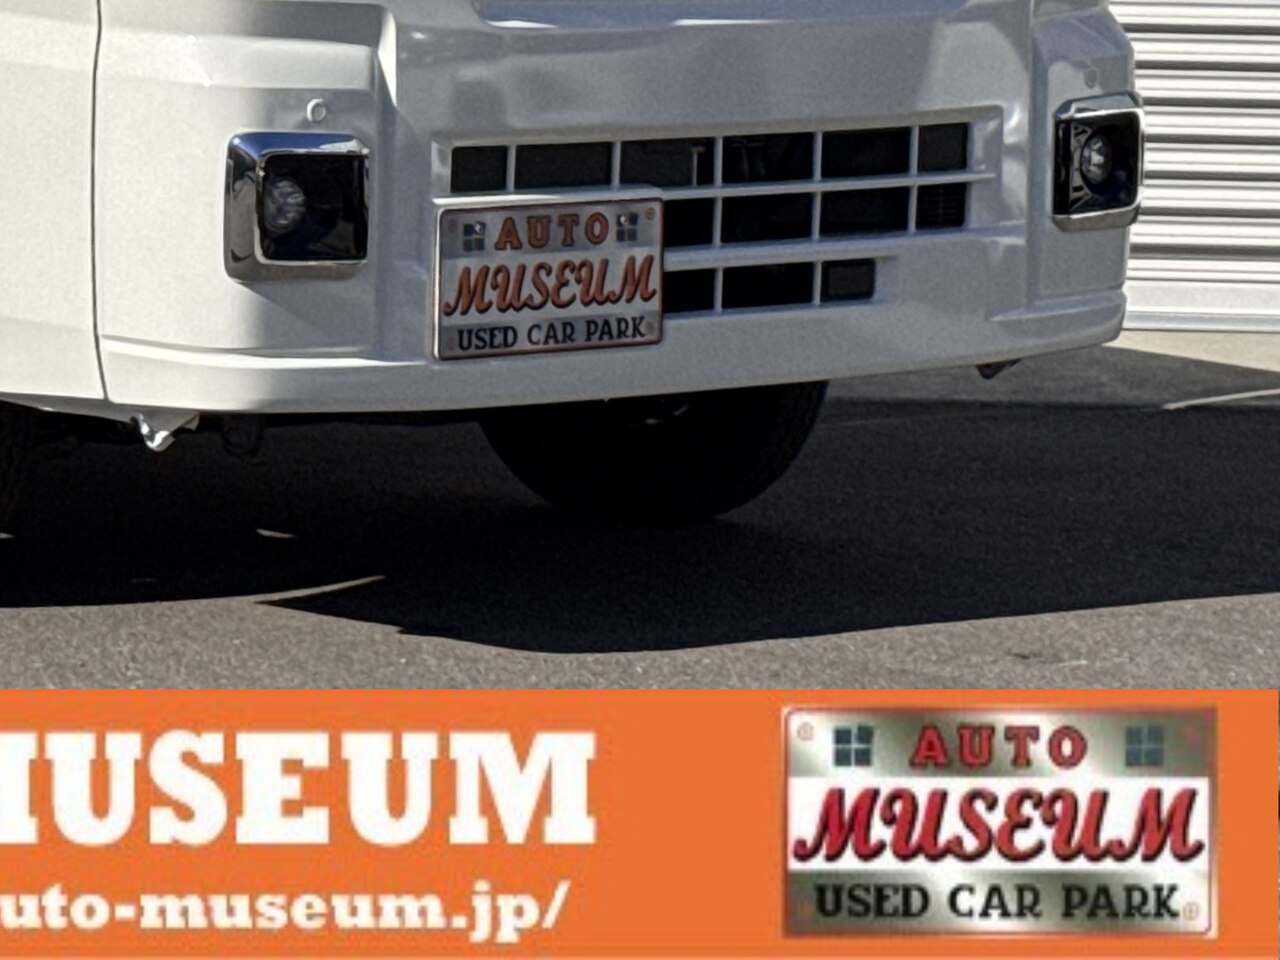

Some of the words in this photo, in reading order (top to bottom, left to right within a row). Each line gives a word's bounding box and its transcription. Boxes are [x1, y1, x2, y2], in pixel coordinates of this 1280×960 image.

[494, 212, 609, 250] AUTO
[443, 254, 657, 316] MUSEUM
[457, 325, 518, 350] USED
[527, 321, 575, 345] CAR
[585, 315, 646, 342] PARK
